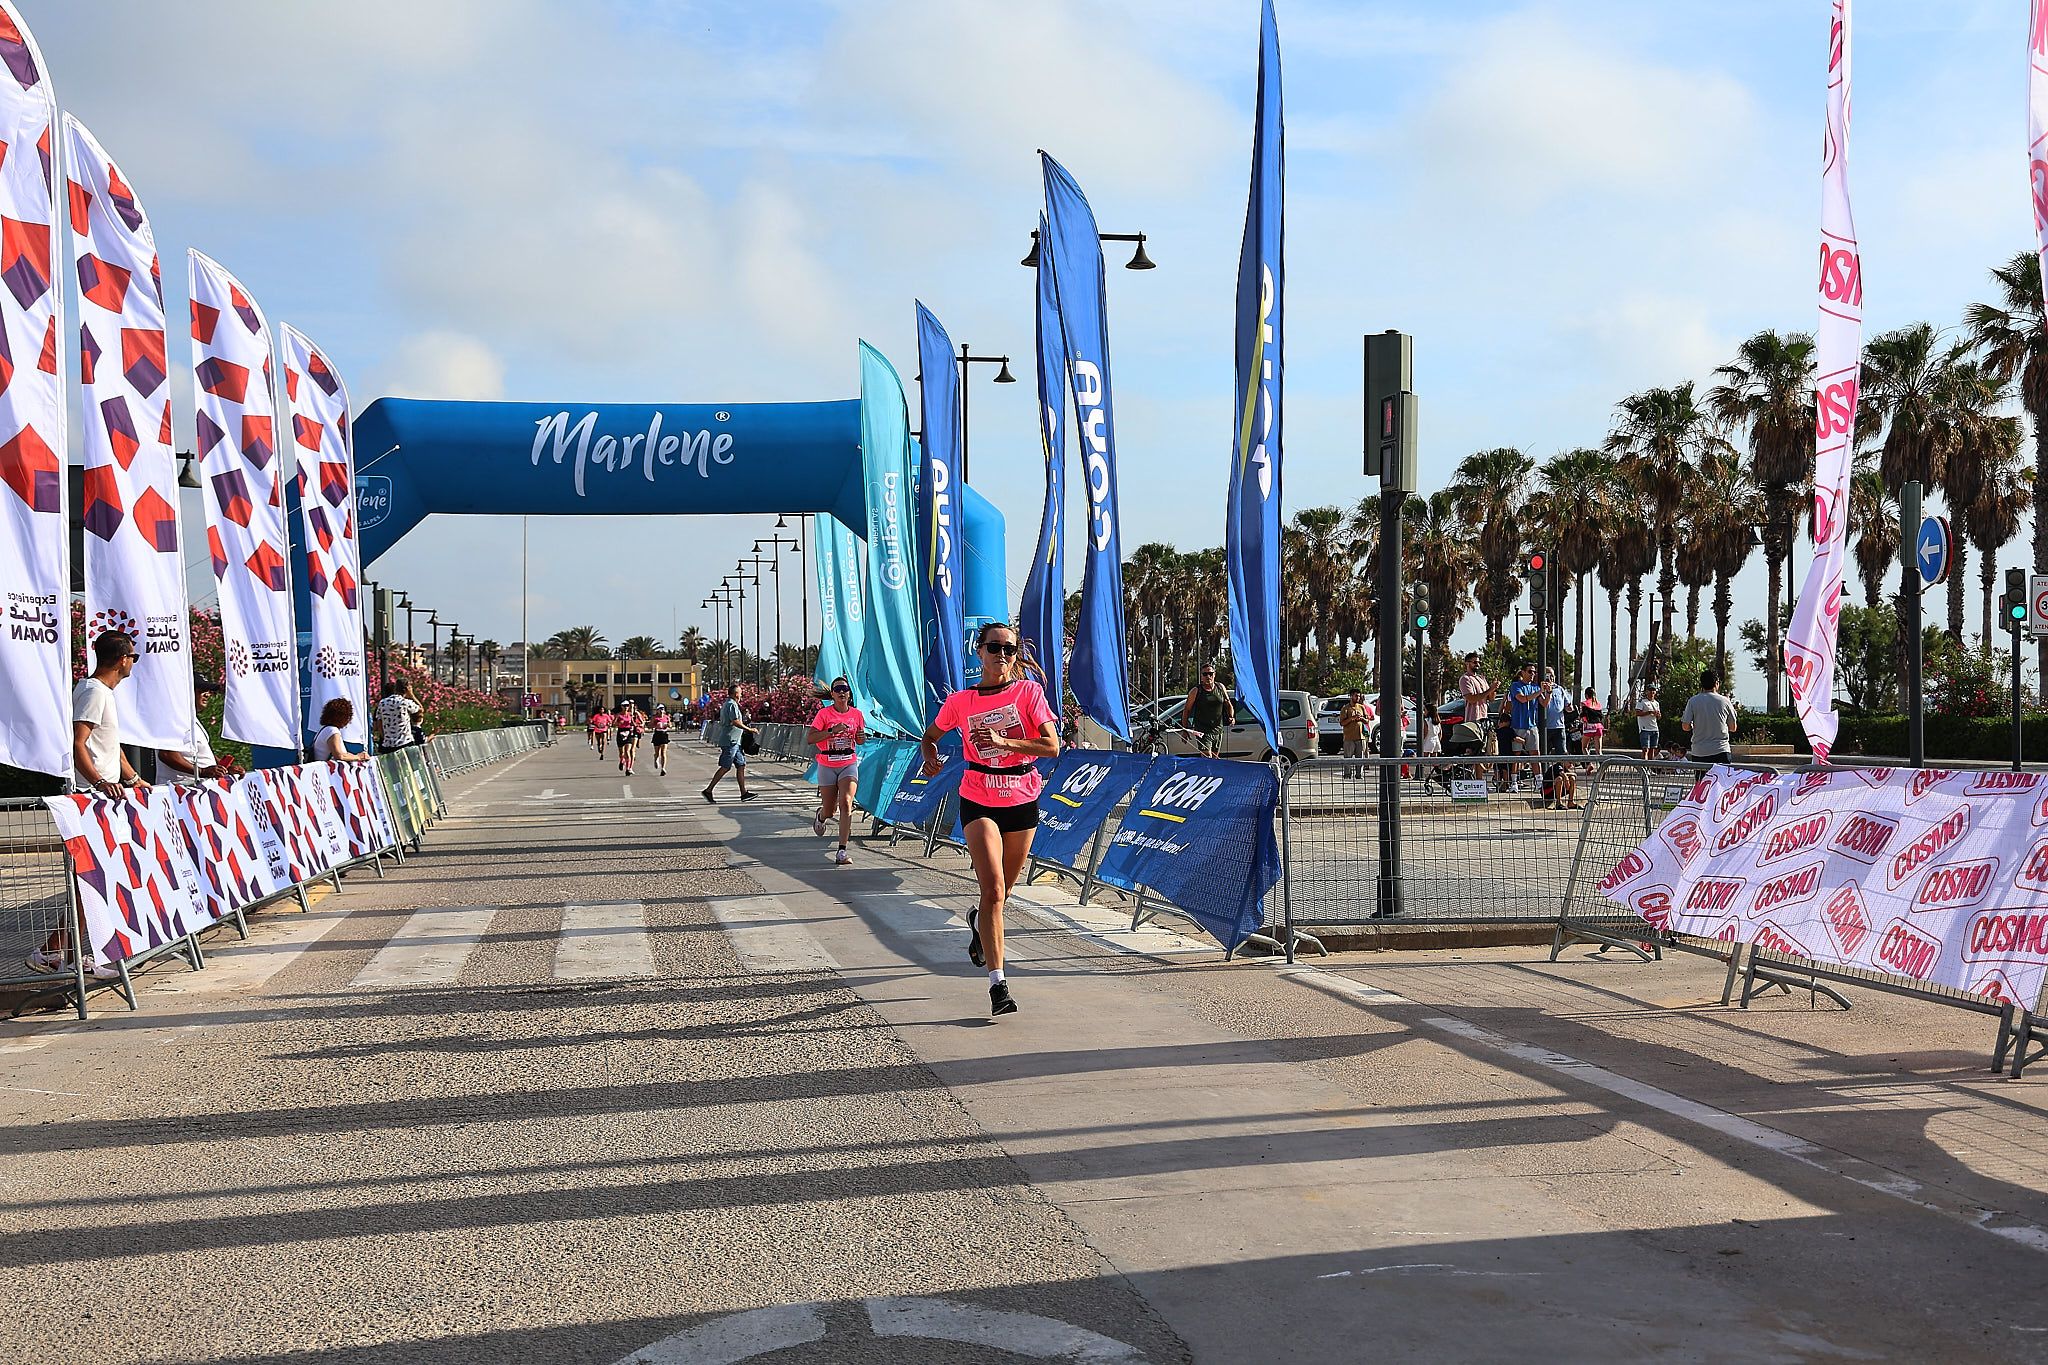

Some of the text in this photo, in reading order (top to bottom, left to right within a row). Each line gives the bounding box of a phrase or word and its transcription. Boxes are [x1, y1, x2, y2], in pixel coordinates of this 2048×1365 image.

[530, 411, 735, 497] Marlene
[356, 488, 387, 510] lene
[1151, 771, 1223, 811] GOYA
[1717, 794, 1774, 850] COSMO
[1765, 816, 1826, 861] COSMO
[1835, 815, 1893, 857] COSMO
[1893, 812, 1964, 880] COSMO
[1686, 880, 1740, 910] COSMO
[1754, 866, 1818, 912] COSMO
[1919, 863, 1992, 904] COSMO
[1827, 887, 1867, 955] COSMO
[1970, 914, 2048, 955] COSMO
[1879, 925, 1936, 980] COSMO
